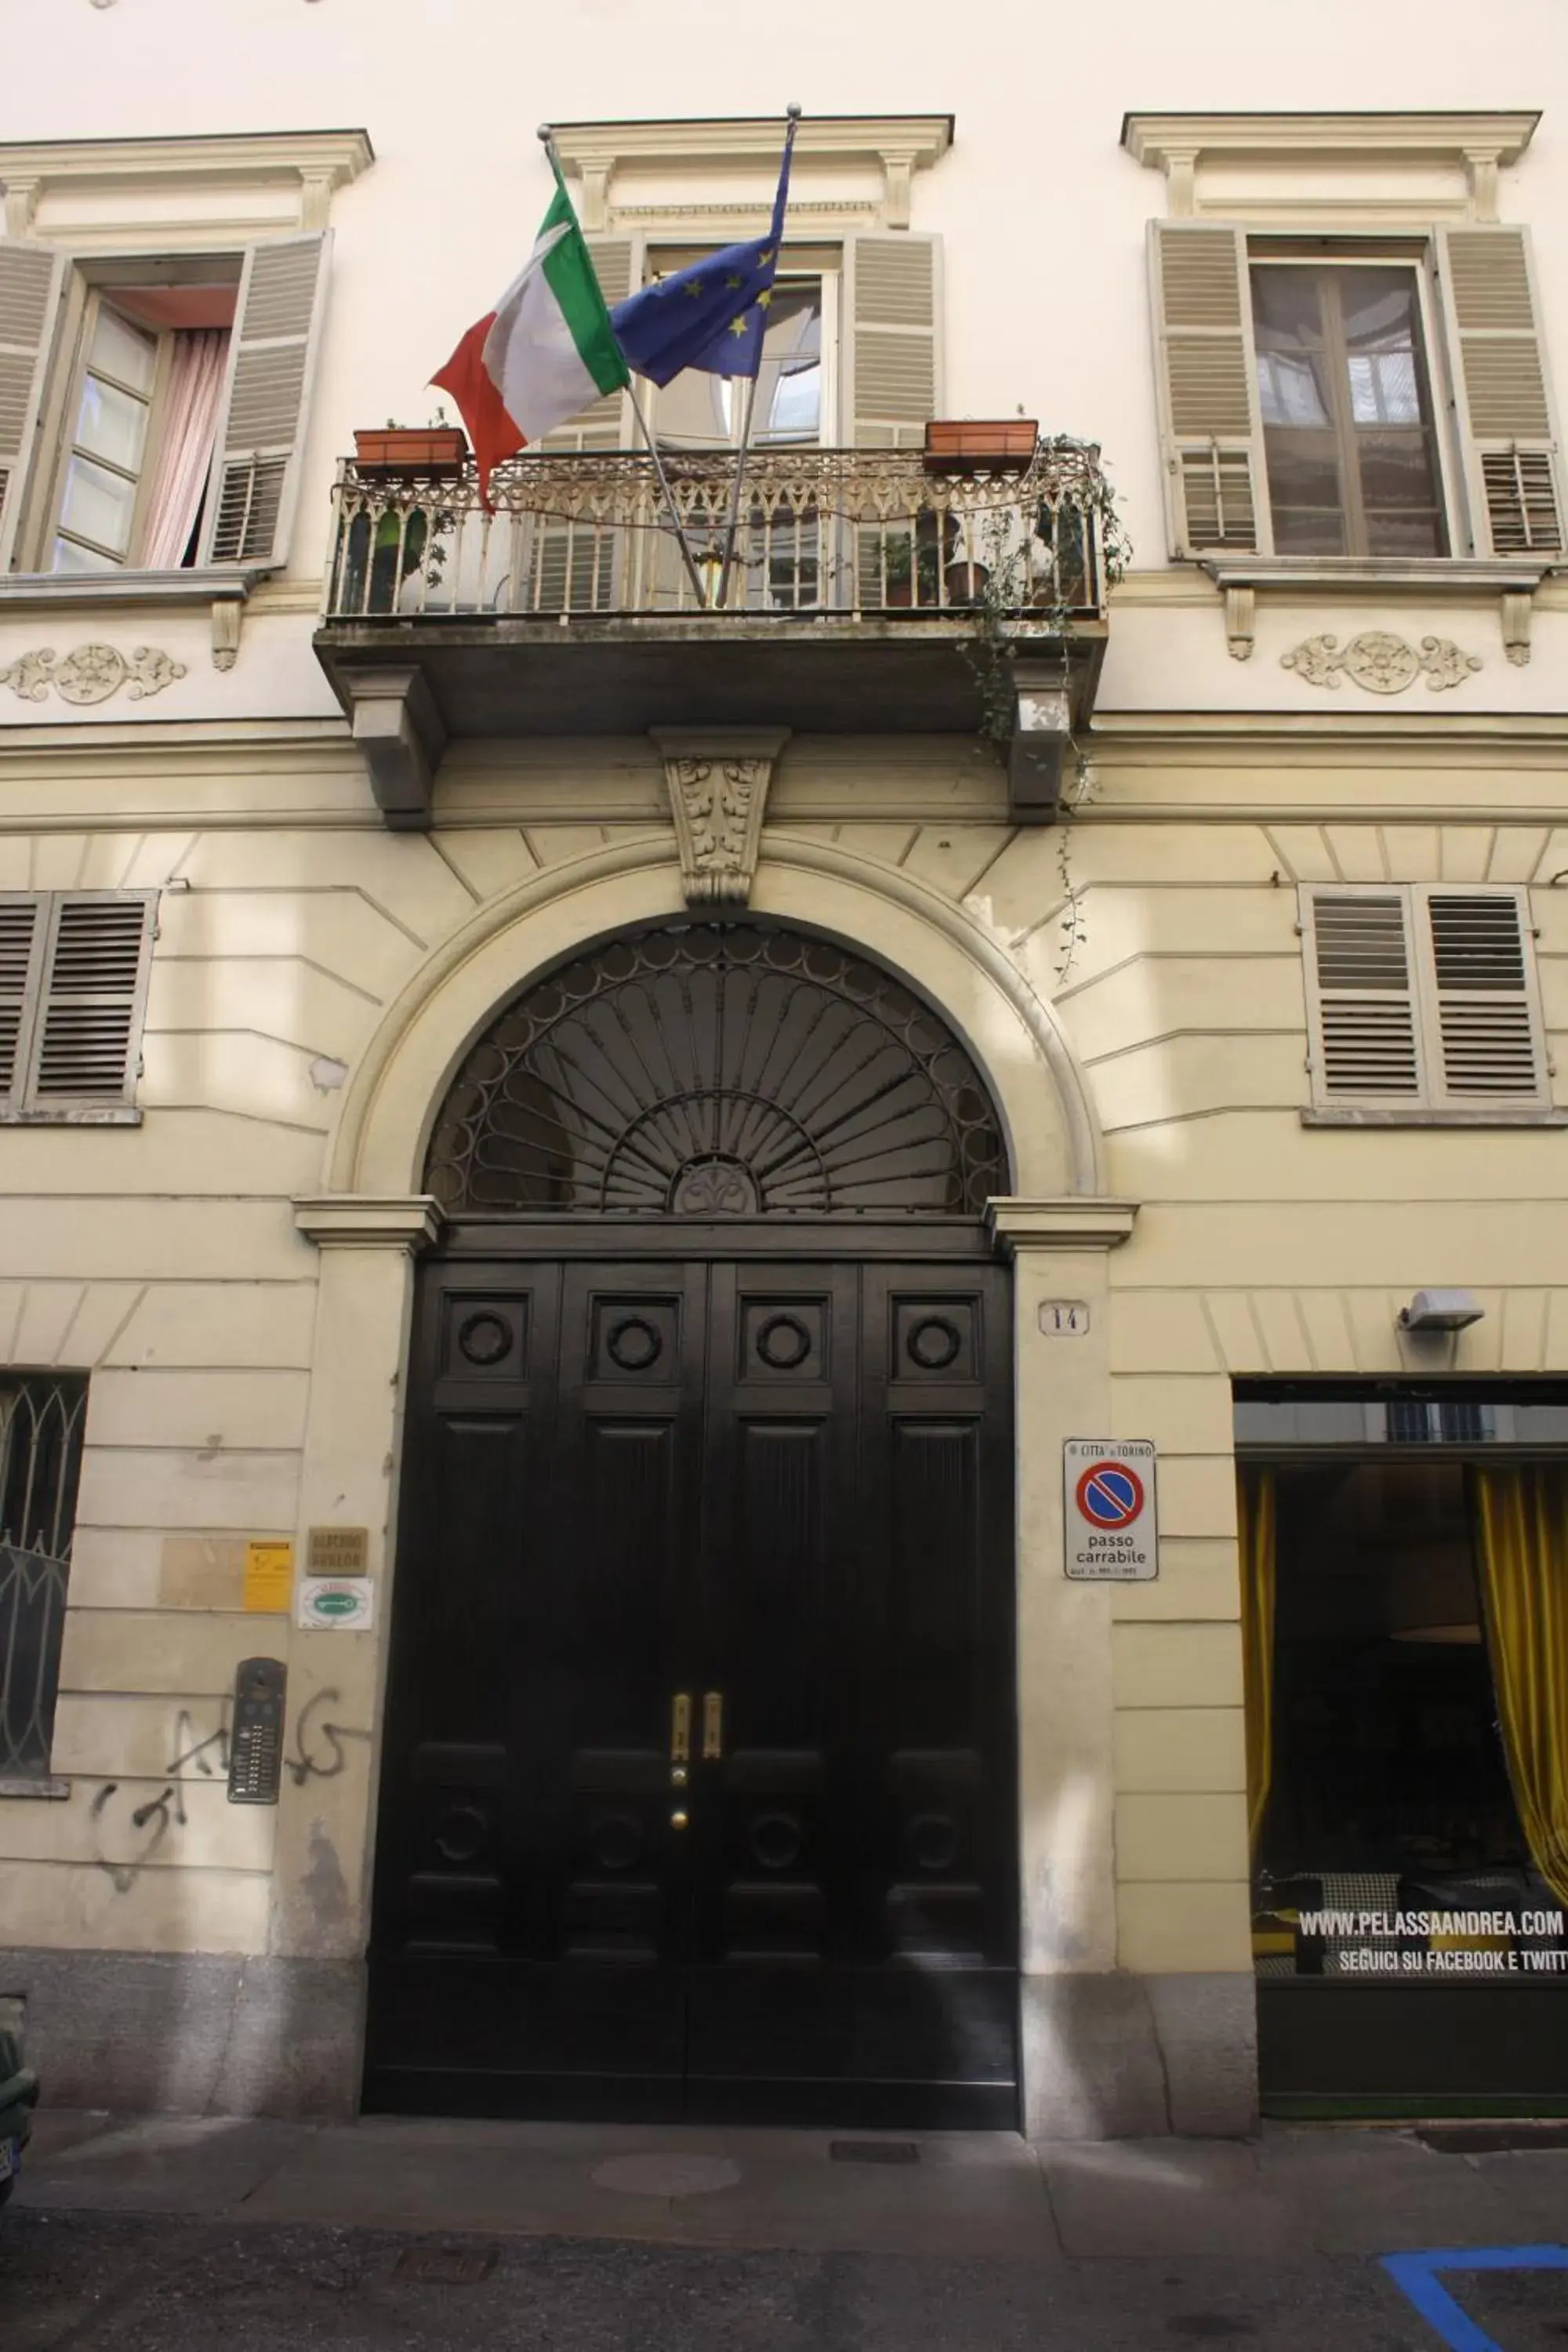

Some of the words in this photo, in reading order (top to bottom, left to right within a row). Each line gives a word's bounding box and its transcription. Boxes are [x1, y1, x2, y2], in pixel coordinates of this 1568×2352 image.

[1052, 1305, 1077, 1329] 14
[1116, 1444, 1152, 1457] TORINO
[1088, 1535, 1134, 1548] passo
[1076, 1550, 1146, 1563] carrabile
[1299, 1911, 1564, 1936] WWW.PELASSAANDREA.COM
[1339, 1951, 1398, 1970] SEGUICI
[1402, 1951, 1423, 1970] SU
[1426, 1951, 1505, 1970] FACEBOOK
[1508, 1950, 1519, 1970] E
